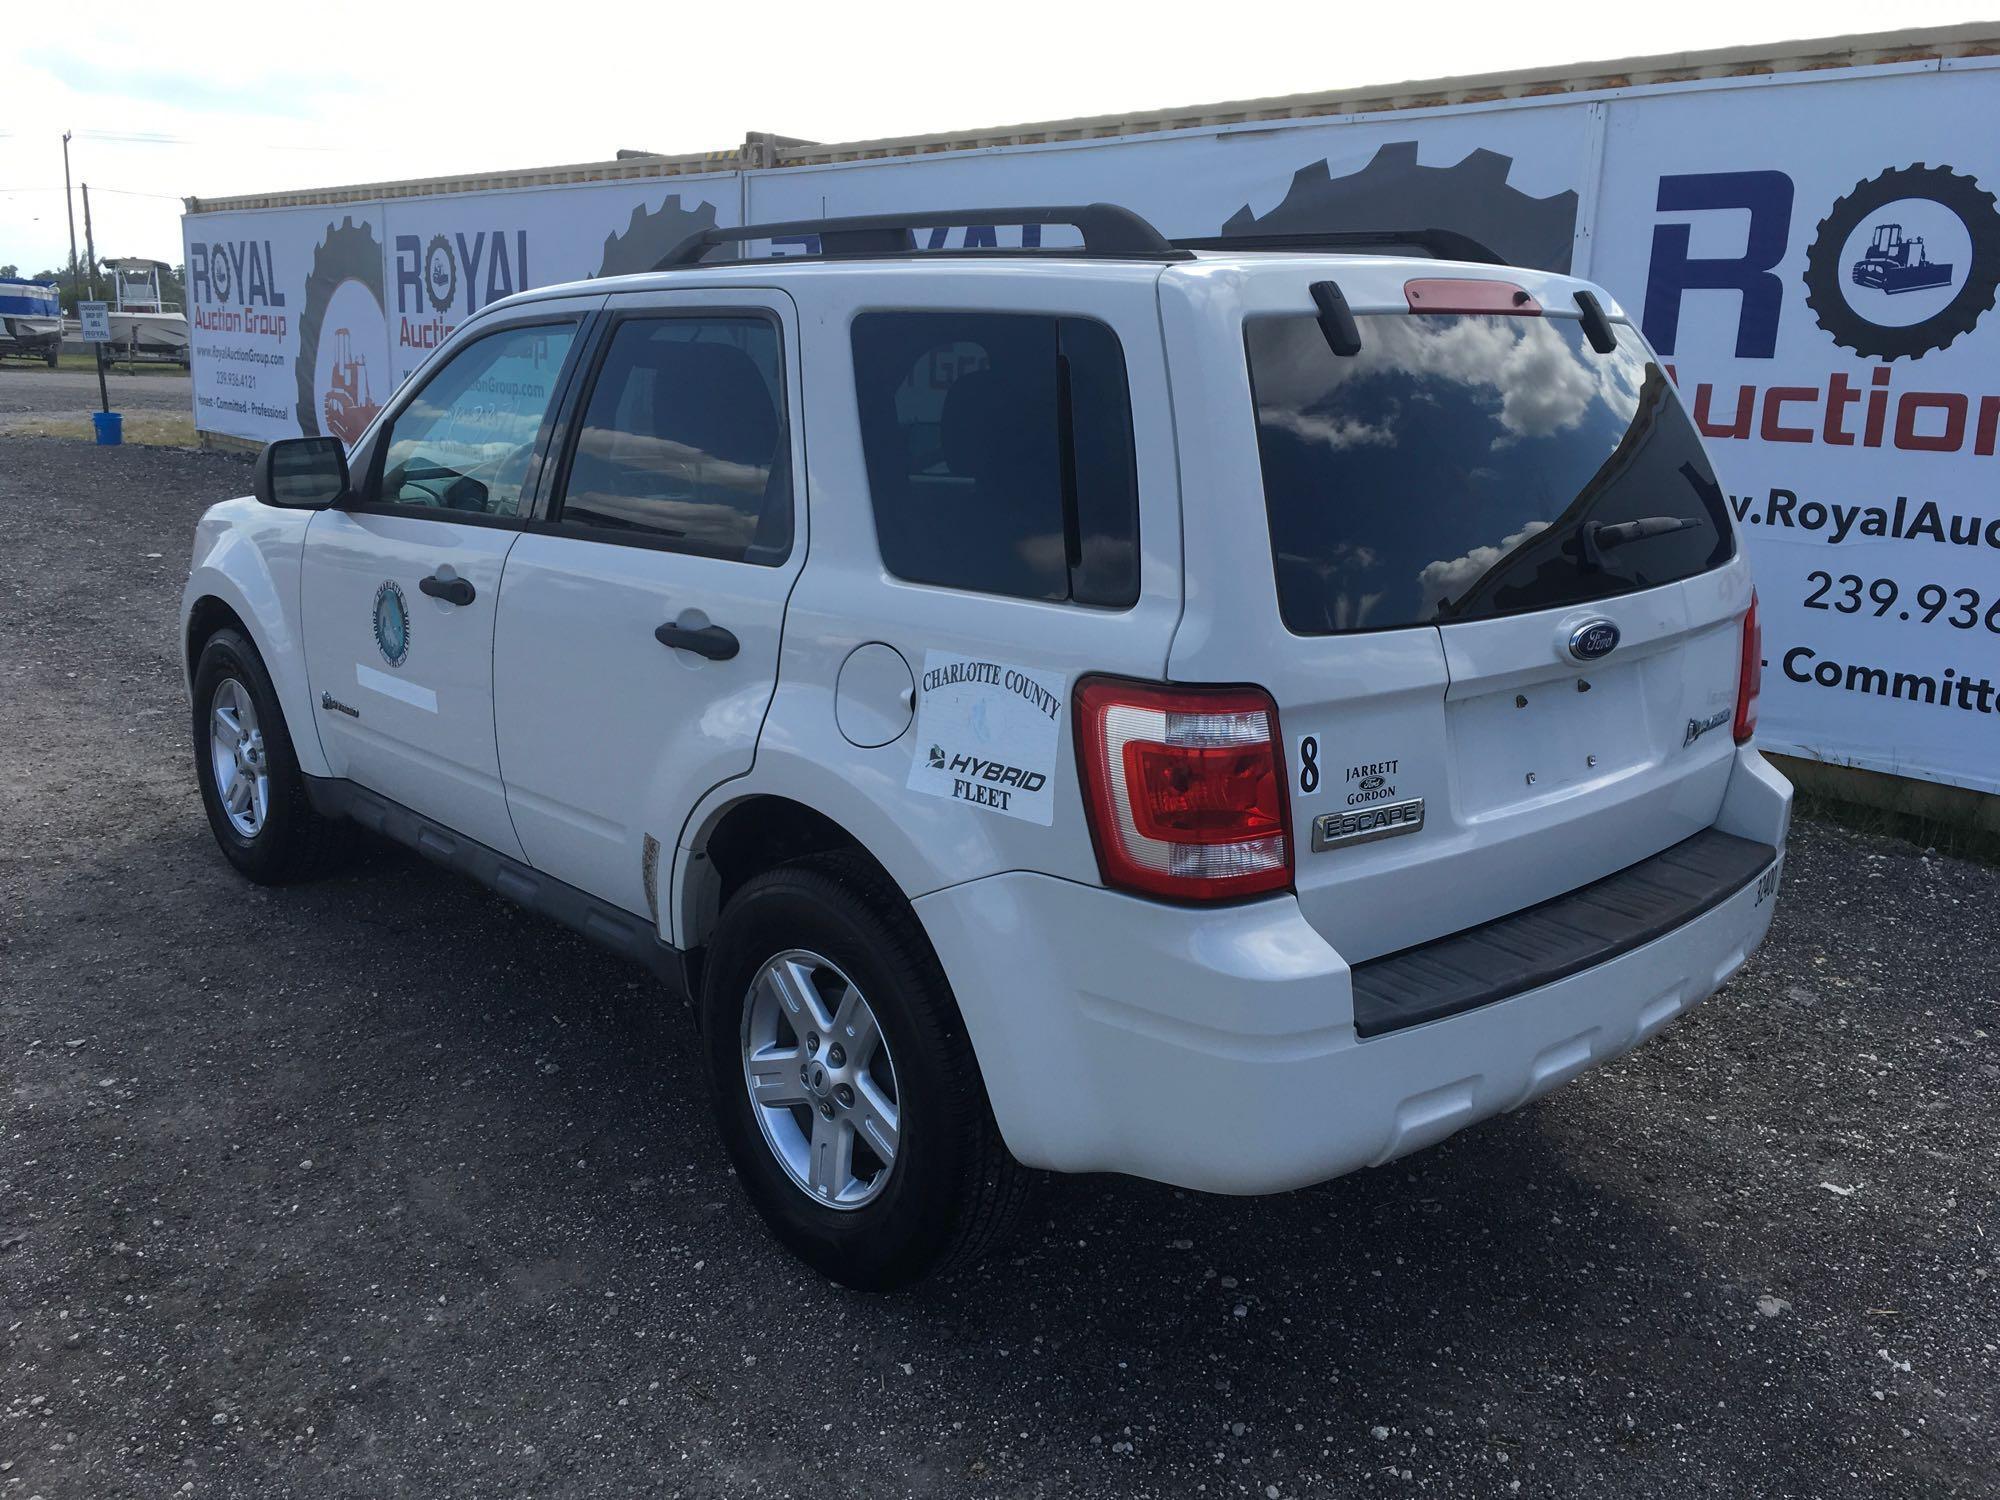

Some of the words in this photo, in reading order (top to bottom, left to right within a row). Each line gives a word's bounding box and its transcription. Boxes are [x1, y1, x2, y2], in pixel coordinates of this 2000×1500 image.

[191, 240, 285, 307] ROYAL
[195, 304, 241, 332] Auction
[245, 308, 286, 344] Group
[400, 316, 456, 348] Aucti
[252, 402, 288, 420] Professional
[1664, 366, 2000, 456] uctio
[923, 662, 1002, 692] CHARLOTTE
[1004, 669, 1061, 720] COUNTY
[1783, 647, 2000, 714] Committ
[949, 753, 1046, 792] HYBRID
[1300, 736, 1319, 793] 8
[1345, 760, 1398, 783] JARRETT
[952, 778, 1011, 810] FLEET
[1347, 786, 1396, 806] GORDON
[1326, 804, 1418, 838] ESCAPE
